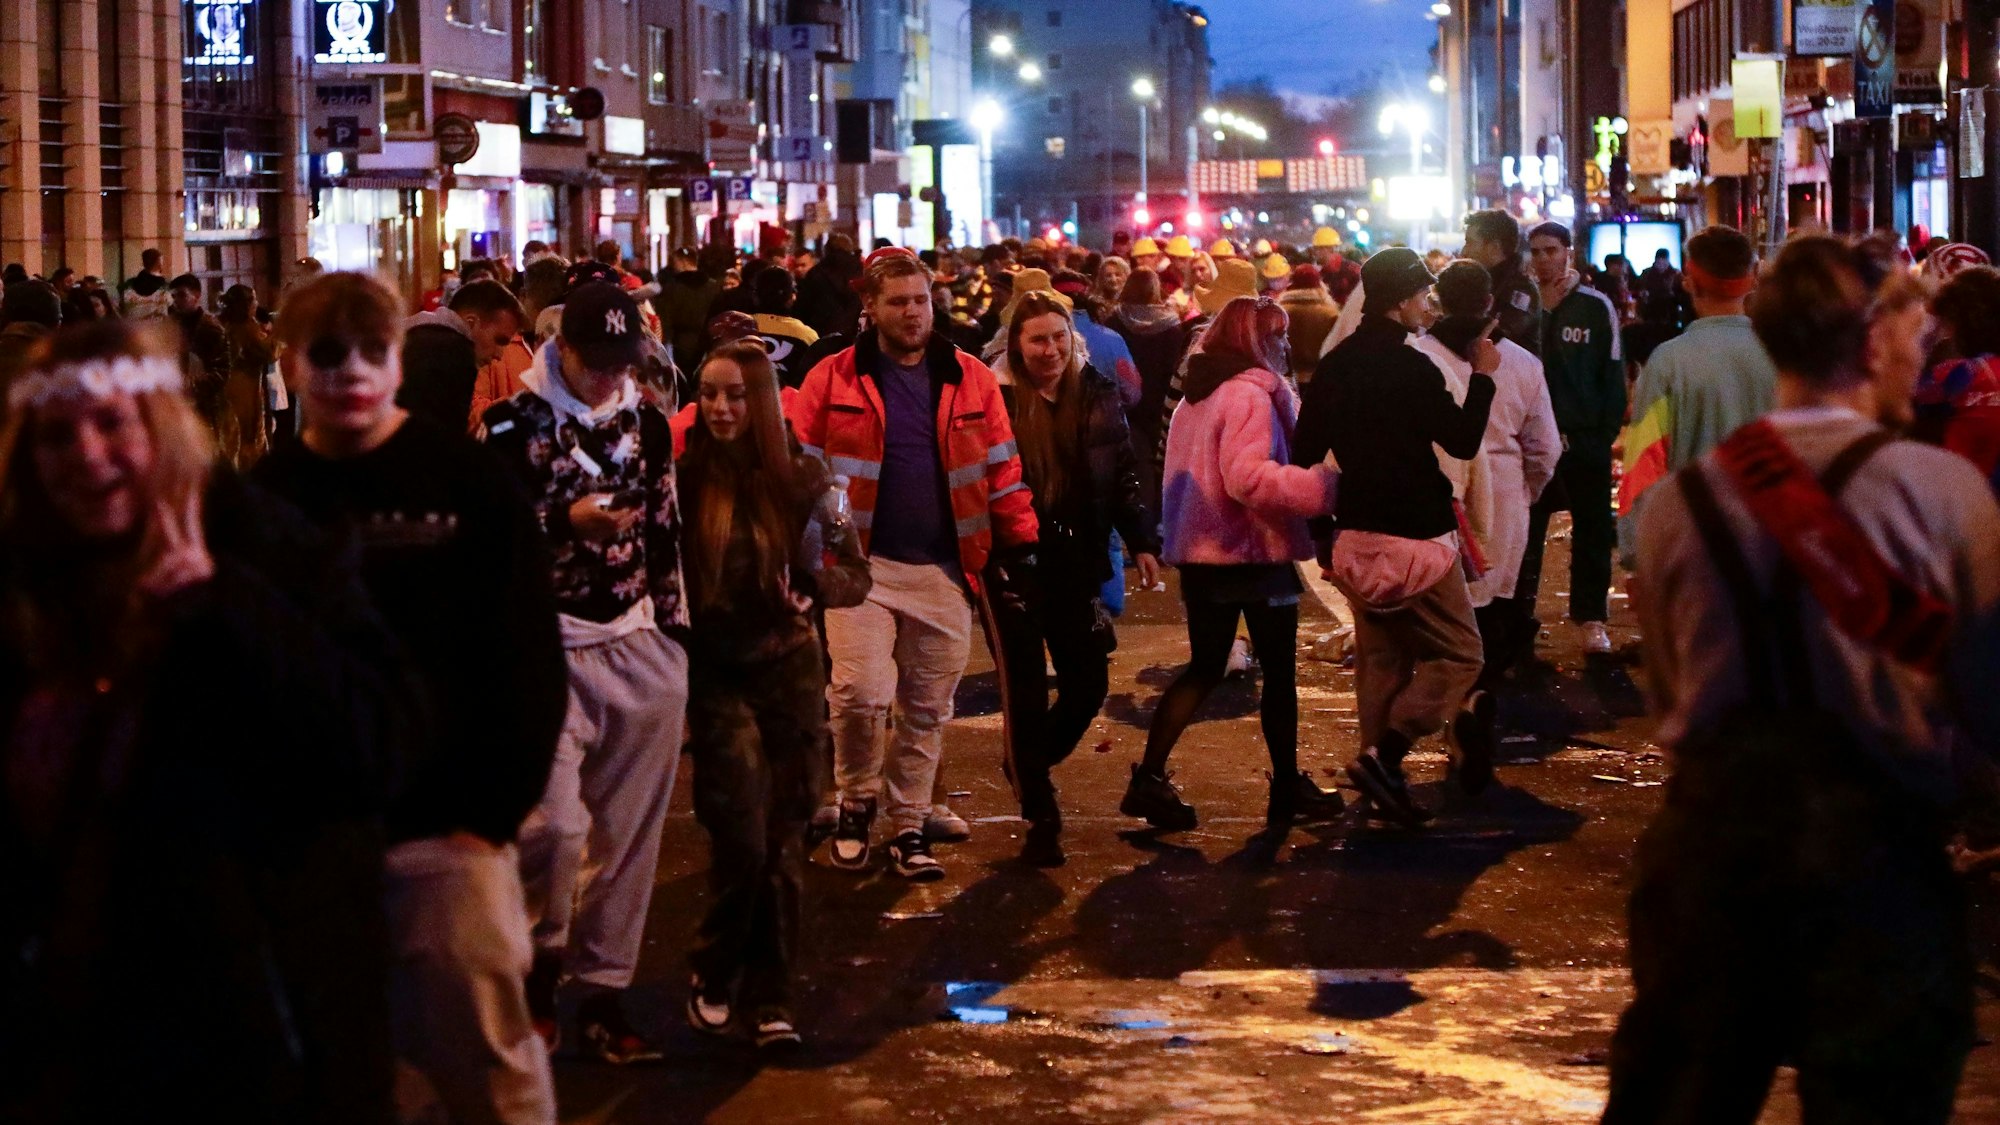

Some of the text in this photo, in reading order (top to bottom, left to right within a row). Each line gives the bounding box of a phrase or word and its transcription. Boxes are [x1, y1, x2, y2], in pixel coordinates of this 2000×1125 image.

[1858, 80, 1889, 105] TAXI
[694, 180, 708, 201] P
[731, 179, 746, 199] P
[1562, 327, 1590, 344] 001
